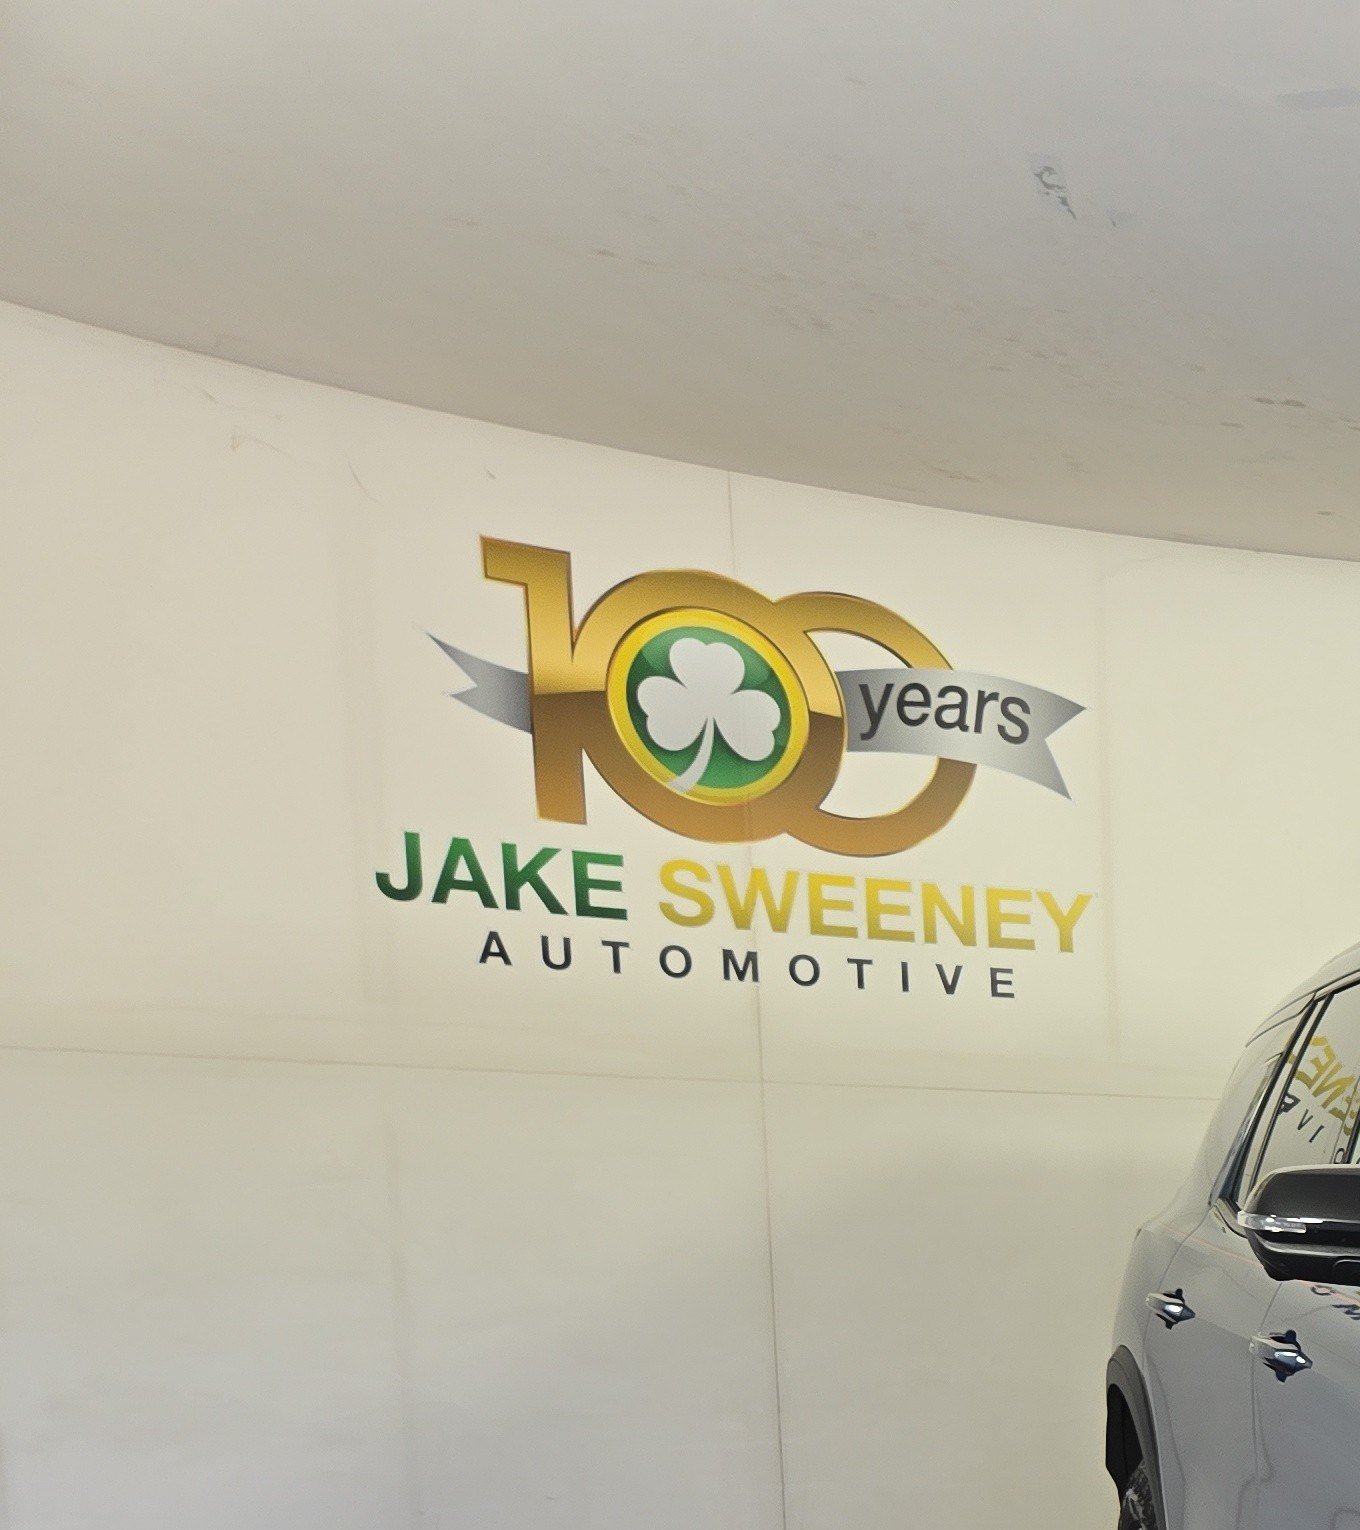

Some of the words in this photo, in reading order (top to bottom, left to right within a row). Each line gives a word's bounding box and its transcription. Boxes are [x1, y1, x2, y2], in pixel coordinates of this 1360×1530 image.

[480, 534, 977, 857] 100
[857, 677, 1031, 745] years
[376, 831, 629, 920] JAKE
[659, 859, 1093, 953] SWEENEY
[479, 930, 1015, 999] AUTOMOTIVE
